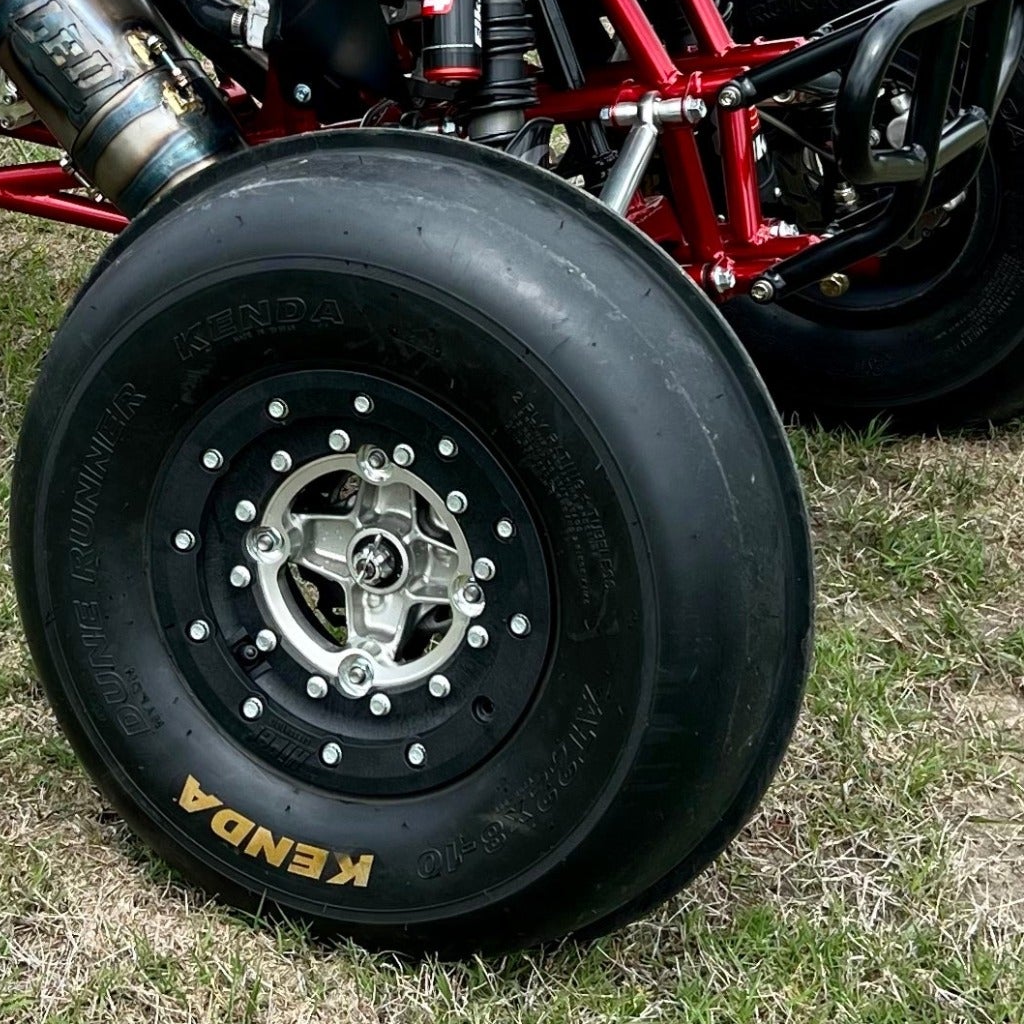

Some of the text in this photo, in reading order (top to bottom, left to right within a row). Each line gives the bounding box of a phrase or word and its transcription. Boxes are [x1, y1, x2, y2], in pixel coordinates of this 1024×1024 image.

[174, 296, 345, 362] KENDA
[68, 382, 151, 737] DUNE RUNNER
[178, 774, 375, 888] KENDA
